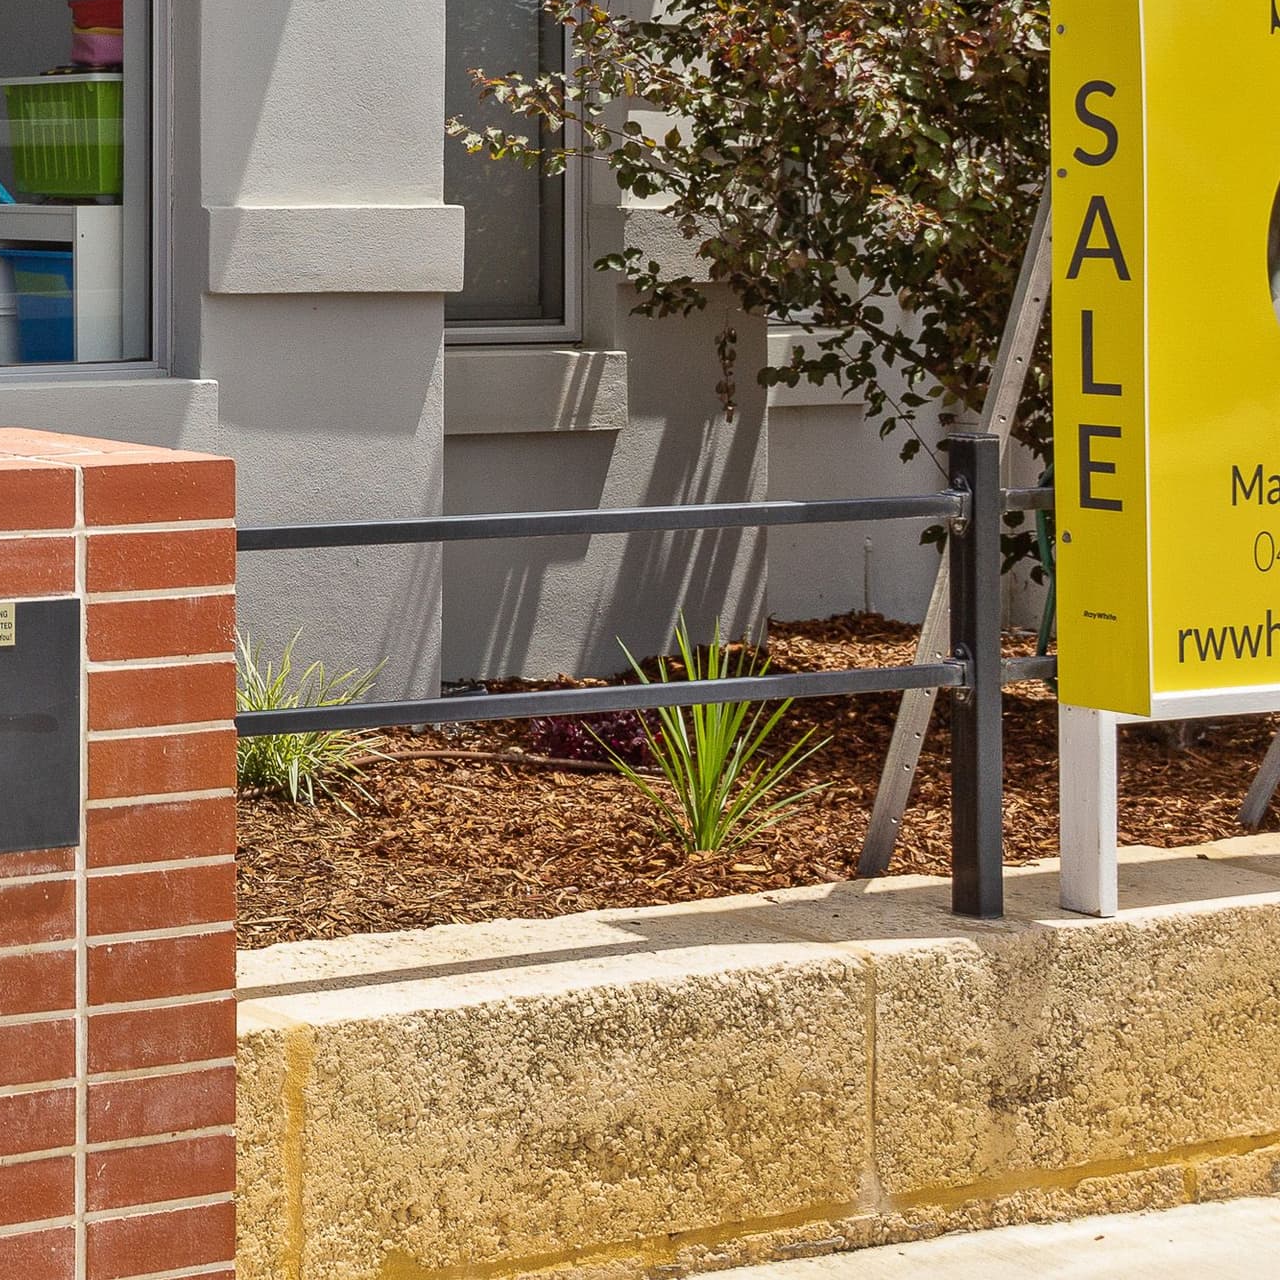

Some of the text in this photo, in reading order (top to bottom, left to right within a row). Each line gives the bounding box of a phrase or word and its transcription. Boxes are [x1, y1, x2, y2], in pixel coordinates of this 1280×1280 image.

[1066, 80, 1131, 512] SALE
[1254, 531, 1280, 572] 0
[1178, 609, 1280, 663] rwwh
